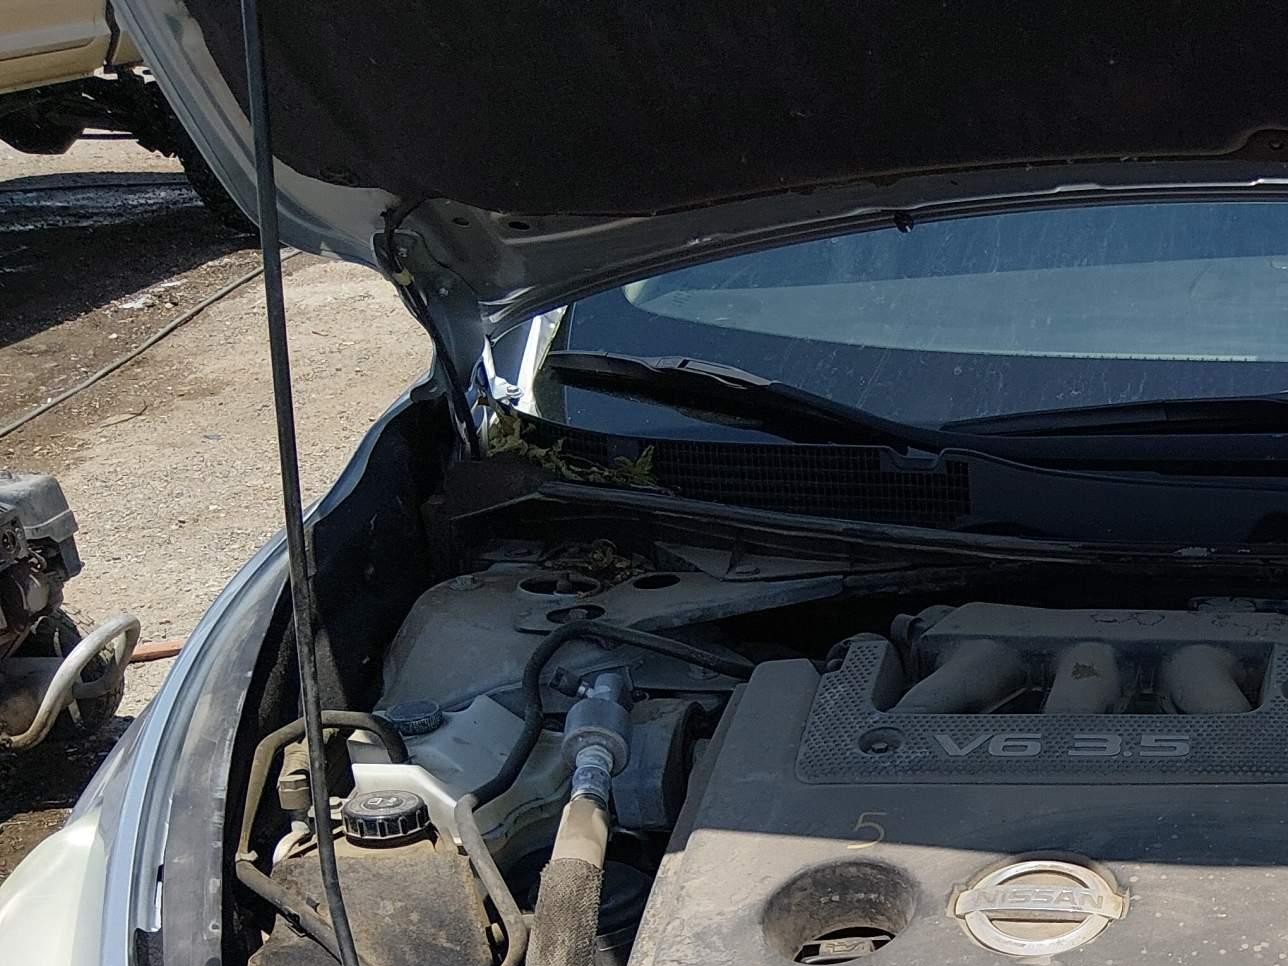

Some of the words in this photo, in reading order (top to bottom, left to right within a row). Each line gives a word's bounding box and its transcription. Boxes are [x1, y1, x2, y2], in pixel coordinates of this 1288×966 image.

[934, 733, 1042, 758] V6
[1068, 734, 1190, 758] 3.5
[846, 811, 887, 850] 5
[973, 887, 1105, 909] NISSAN
